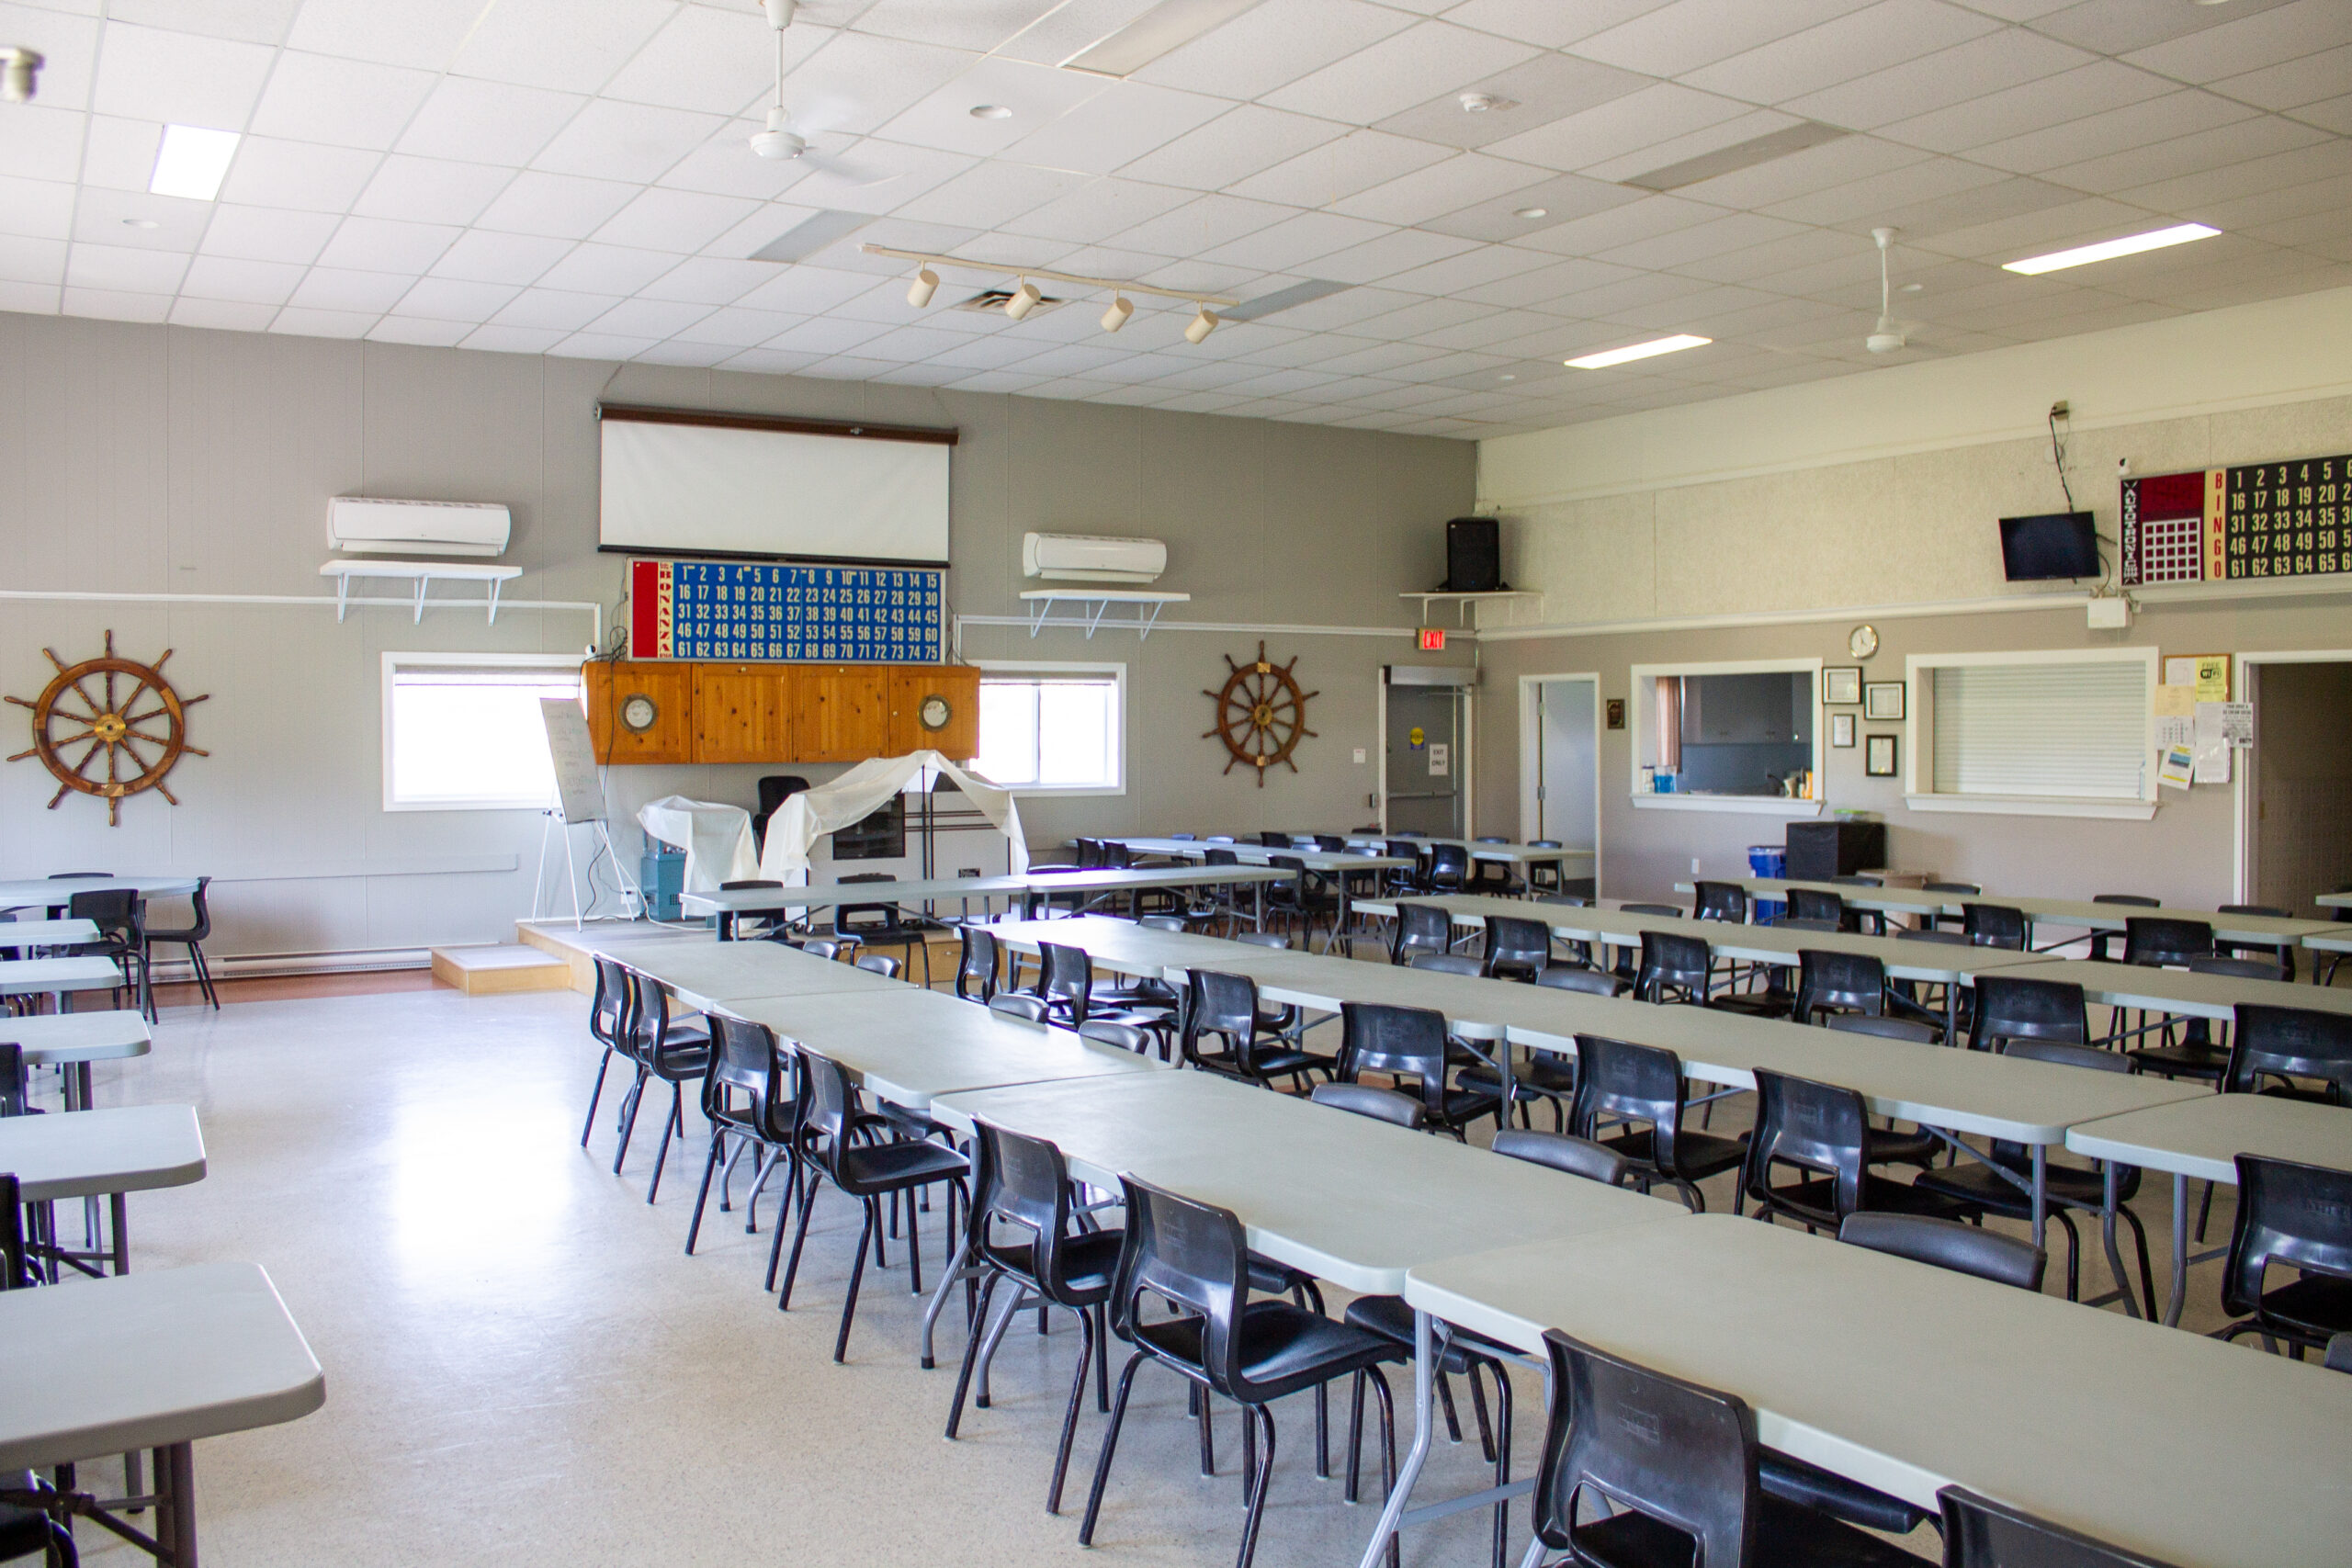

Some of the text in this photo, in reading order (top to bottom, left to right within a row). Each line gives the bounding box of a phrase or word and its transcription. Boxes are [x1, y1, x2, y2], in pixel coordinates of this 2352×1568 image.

[2235, 470, 2242, 489] 1
[2256, 468, 2264, 486] 2
[2278, 466, 2286, 483] 3
[2301, 464, 2308, 481] 4
[2324, 461, 2331, 479] 5
[2232, 482, 2351, 510] 16 17 18 19 20 2
[2213, 471, 2223, 580] BINGO
[2231, 505, 2352, 533] 31 32 33 34 35 3
[2230, 529, 2351, 554] 46 47 48 49 50 5
[682, 566, 687, 581] 1
[699, 566, 706, 581] 2
[718, 567, 724, 581] 3
[736, 568, 742, 581] 4
[753, 569, 760, 582] 5
[772, 569, 778, 582] 6
[790, 570, 796, 582] 7
[808, 570, 814, 583] 8
[825, 570, 831, 584] 9
[842, 571, 852, 584] 10
[859, 571, 867, 584] 11
[876, 572, 886, 586] 12
[892, 573, 902, 586] 13
[909, 573, 919, 586] 14
[927, 574, 936, 588] 15
[2231, 552, 2352, 577] 61 62 63 64 65 6
[678, 584, 937, 605] 16 17 18 19 20 21 22 23 24 25 26 27 28 29 30
[659, 570, 672, 651] BONANZA
[678, 604, 937, 623] 31 32 33 34 35 36 37 38 39 40 41 42 43 44 45
[677, 623, 937, 641] 46 47 48 49 50 51 52 53 54 55 56 57 58 59 60
[1423, 631, 1443, 649] EXIT
[678, 641, 936, 660] 61 62 63 64 65 66 67 68 69 70 71 72 73 74 75
